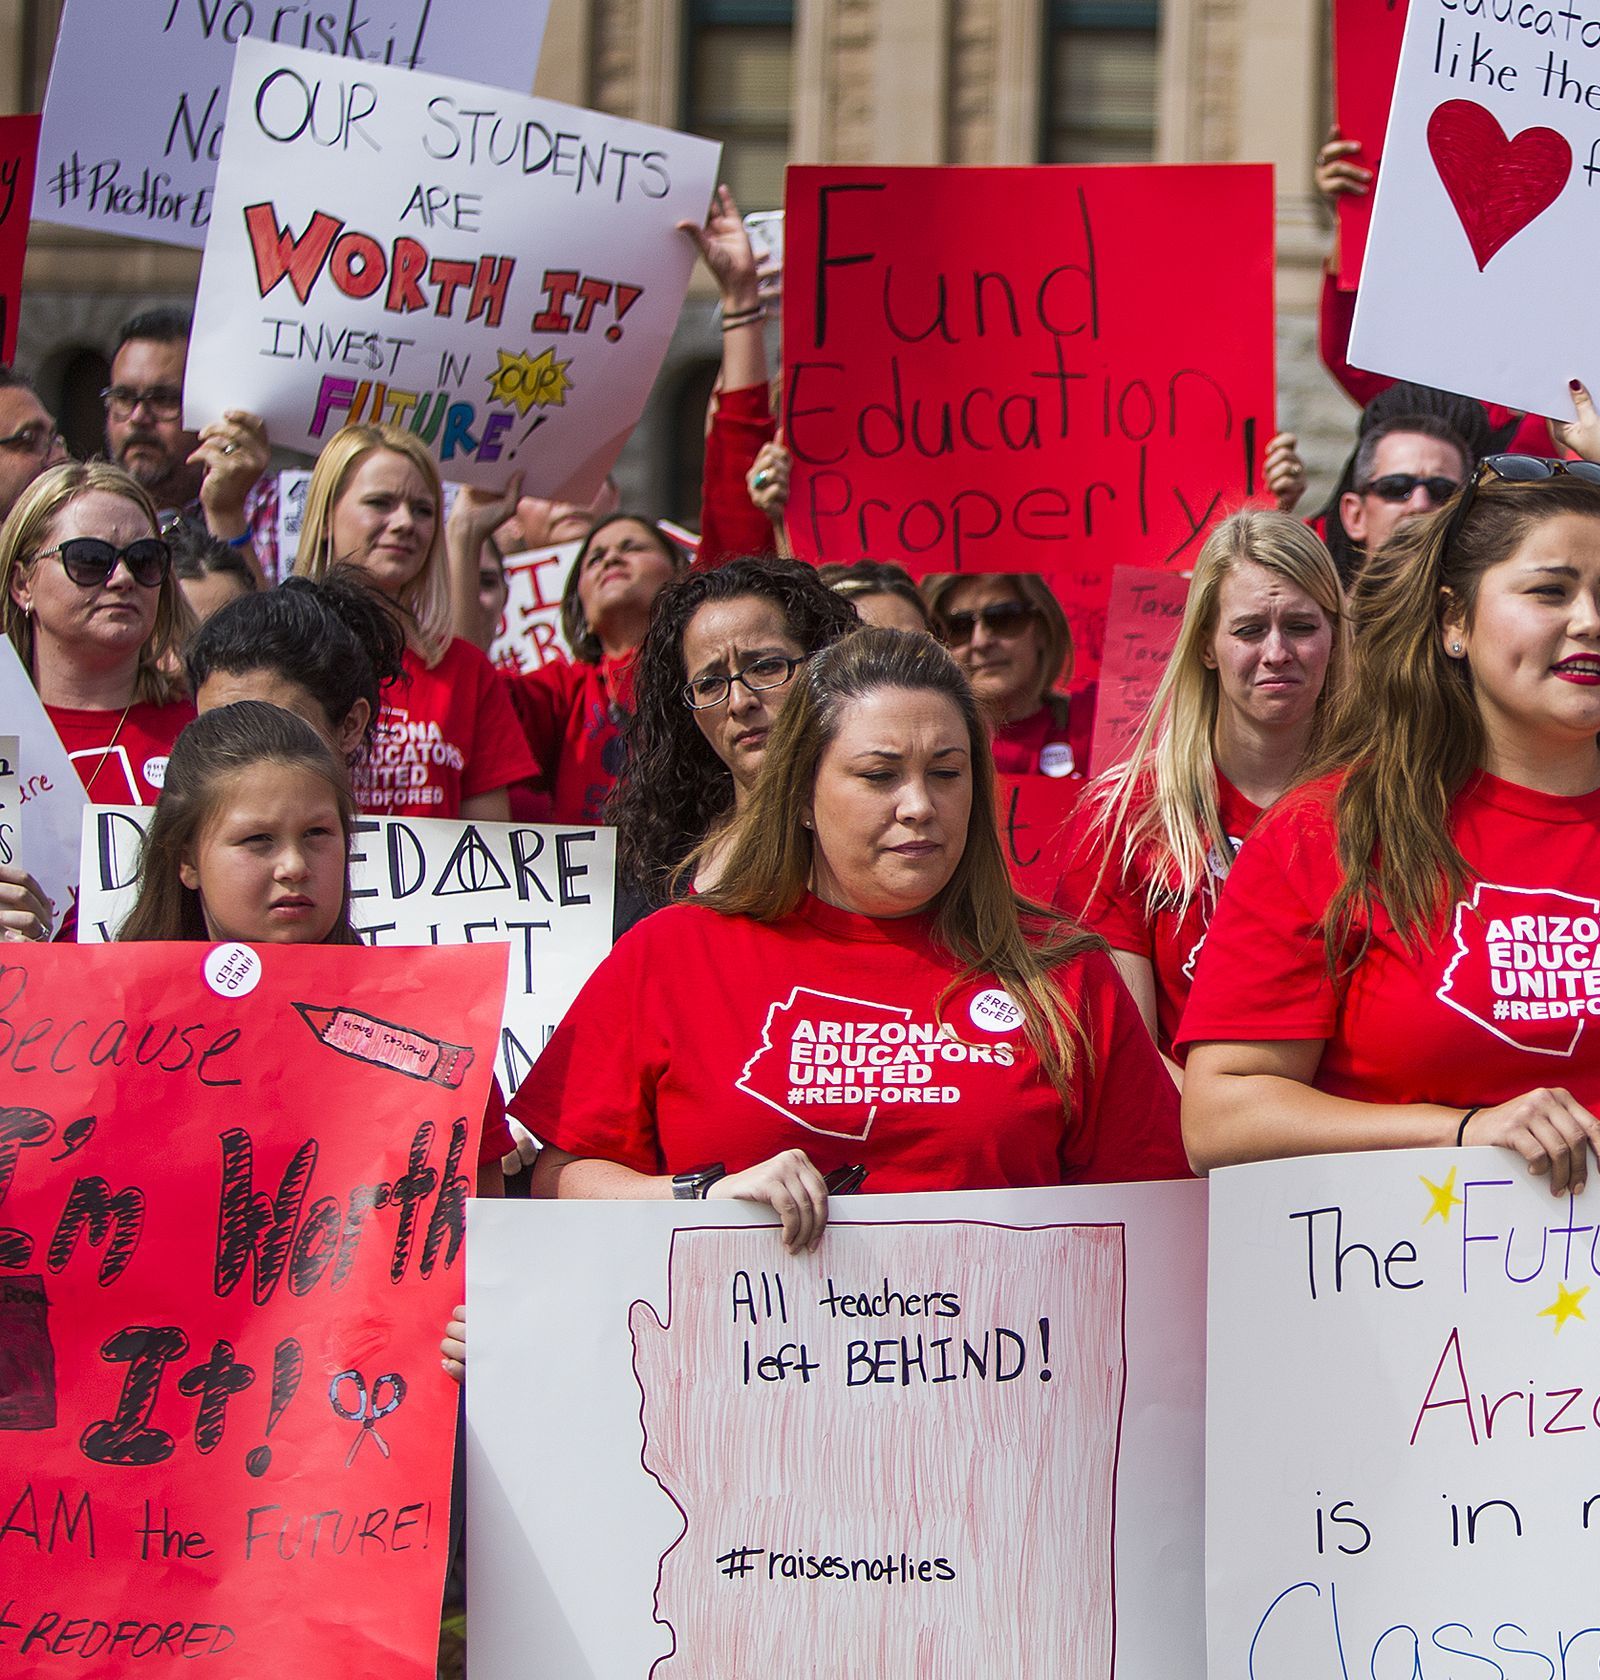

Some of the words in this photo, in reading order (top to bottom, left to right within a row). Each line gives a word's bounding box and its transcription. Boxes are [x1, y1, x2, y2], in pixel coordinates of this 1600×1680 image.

[1434, 18, 1517, 91] like
[255, 68, 382, 151] OUR
[422, 96, 672, 202] STUDENTS
[400, 184, 483, 233] ARE
[243, 202, 517, 328] WORTH
[531, 271, 643, 344] IT!
[815, 184, 1098, 348] Fund
[438, 350, 471, 388] IN
[501, 363, 556, 394] OUR
[786, 336, 1231, 464] Education
[309, 375, 547, 463] FUTURE!
[809, 417, 1256, 571] Properly!
[215, 949, 245, 983] forED
[227, 956, 254, 990] #RED
[791, 1020, 958, 1044] ARIZONA
[976, 1001, 1014, 1024] forED
[983, 994, 1019, 1015] #RED
[788, 1064, 932, 1085] UNITED
[790, 1042, 1015, 1066] EDUCATORS
[787, 1086, 961, 1104] #REDFORED
[214, 1117, 468, 1306] Worth
[1290, 1207, 1424, 1300] The
[733, 1271, 787, 1323] All
[820, 1278, 961, 1318] teachers
[743, 1340, 820, 1385] left
[847, 1317, 1053, 1386] BEHIND!
[79, 1326, 303, 1477] It!
[135, 1500, 214, 1560] the
[246, 1501, 431, 1560] FUTURE!
[1316, 1491, 1371, 1554] is
[1442, 1494, 1522, 1546] in
[716, 1546, 956, 1584] #raisesnotlies
